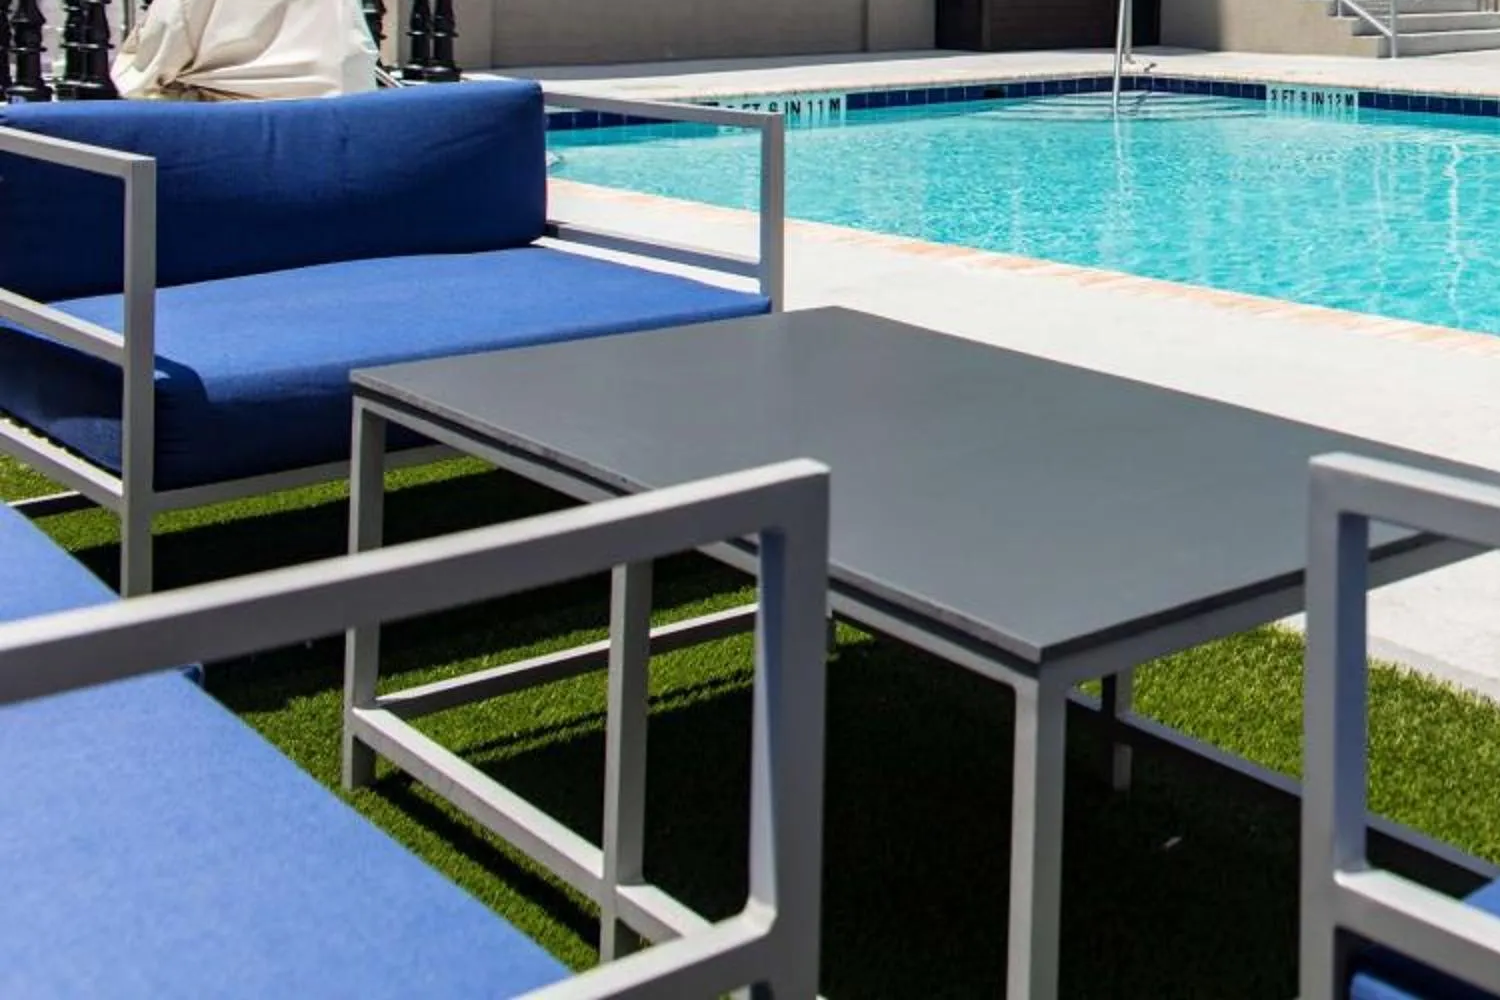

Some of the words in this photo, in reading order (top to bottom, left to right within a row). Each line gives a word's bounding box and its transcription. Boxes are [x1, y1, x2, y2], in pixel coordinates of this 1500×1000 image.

[1311, 92, 1325, 105] IN
[785, 101, 801, 114] IN
[829, 98, 841, 111] M
